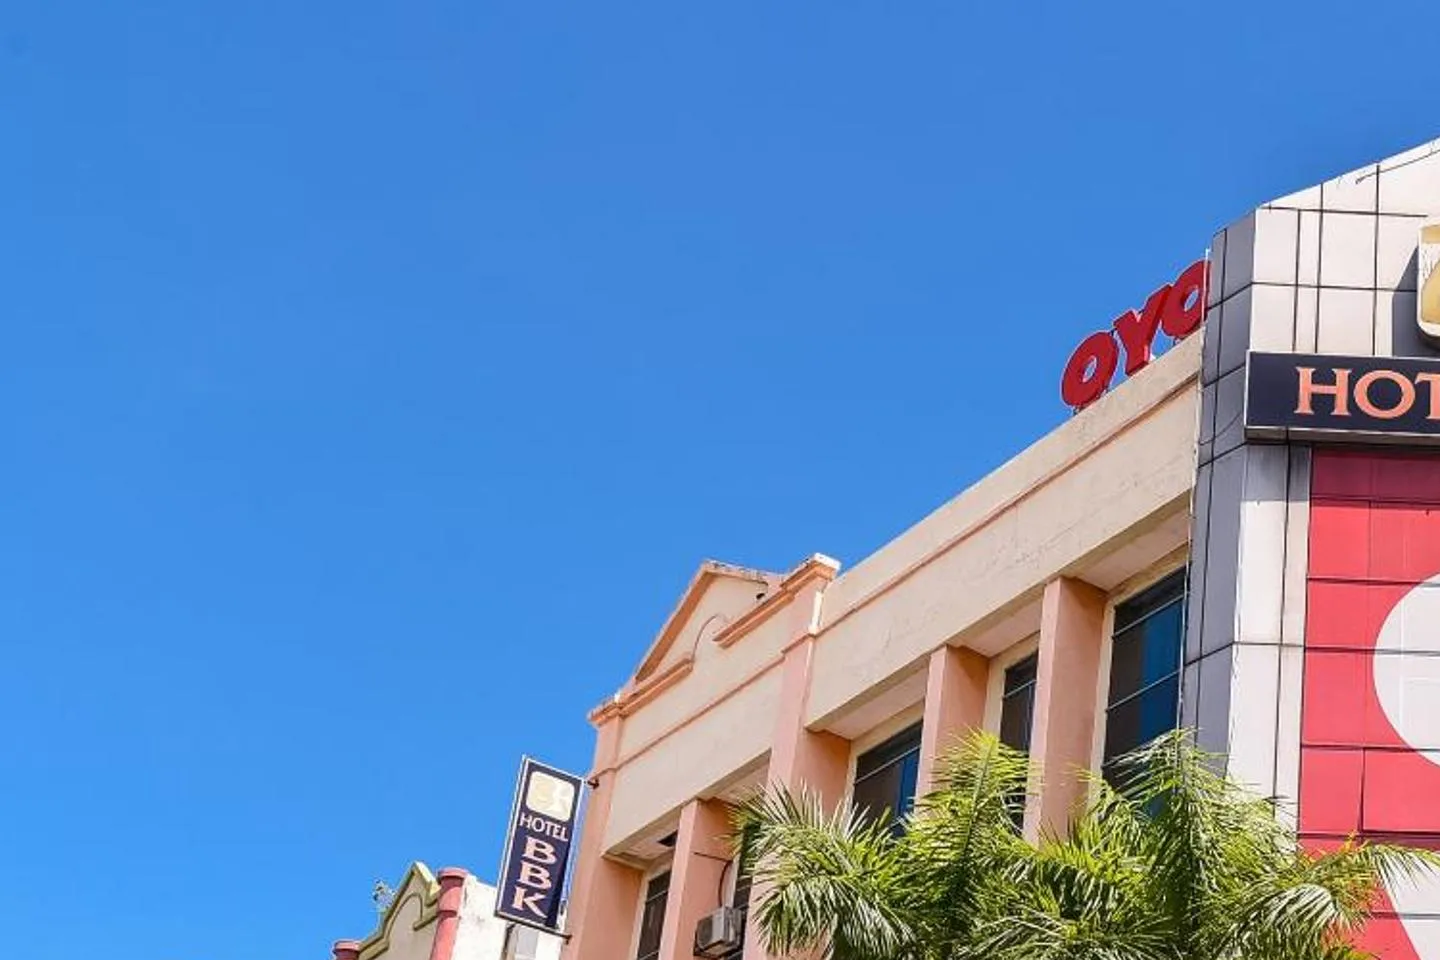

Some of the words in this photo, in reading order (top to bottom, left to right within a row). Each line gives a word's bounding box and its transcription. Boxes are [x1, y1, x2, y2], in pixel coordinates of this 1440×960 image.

[1061, 261, 1211, 407] OYO
[519, 812, 569, 842] HOTEL
[512, 835, 557, 918] BBK
